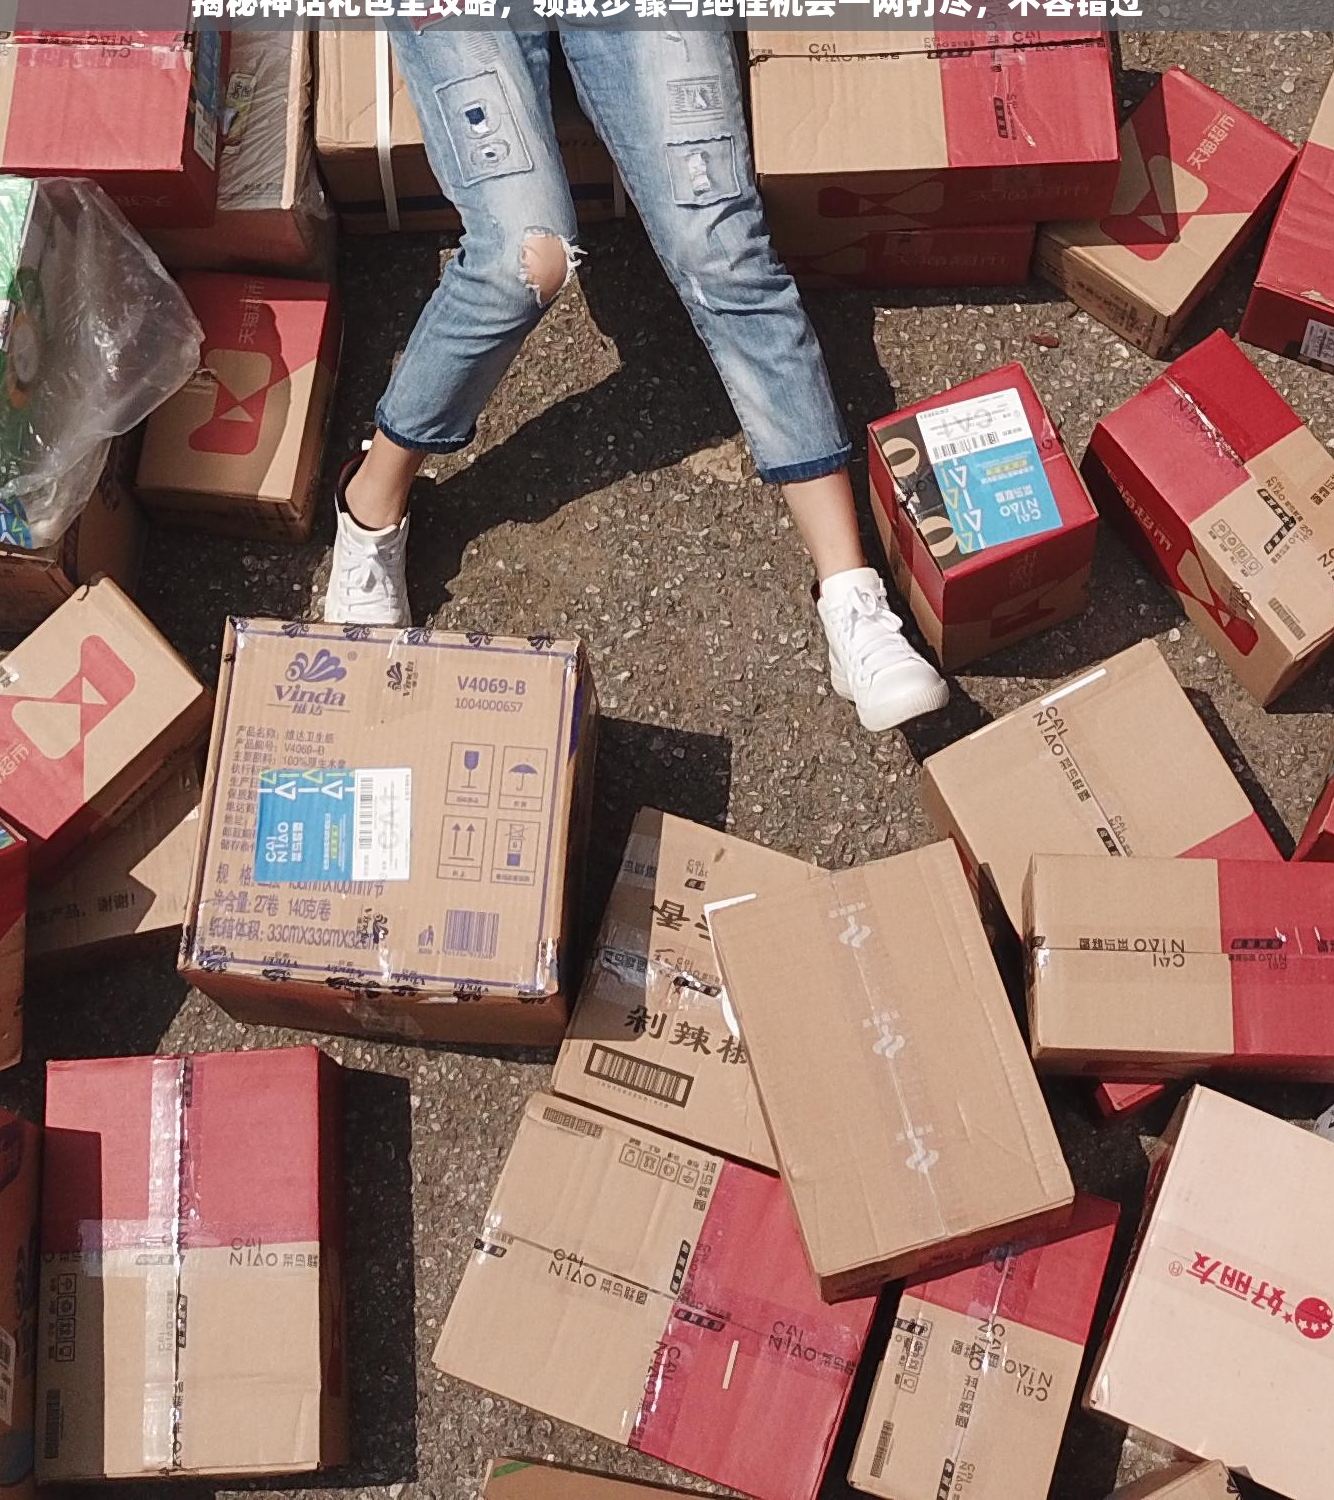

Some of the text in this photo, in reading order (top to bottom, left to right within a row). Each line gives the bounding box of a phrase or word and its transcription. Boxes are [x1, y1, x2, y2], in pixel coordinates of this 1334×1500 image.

[1188, 113, 1237, 172] 天猫超市
[274, 684, 347, 708] Vinda
[456, 674, 527, 697] V4069-B
[454, 697, 524, 715] 1004000657
[266, 837, 277, 863] CAI
[277, 821, 289, 863] NIAO
[1185, 1250, 1286, 1316] 好丽友
